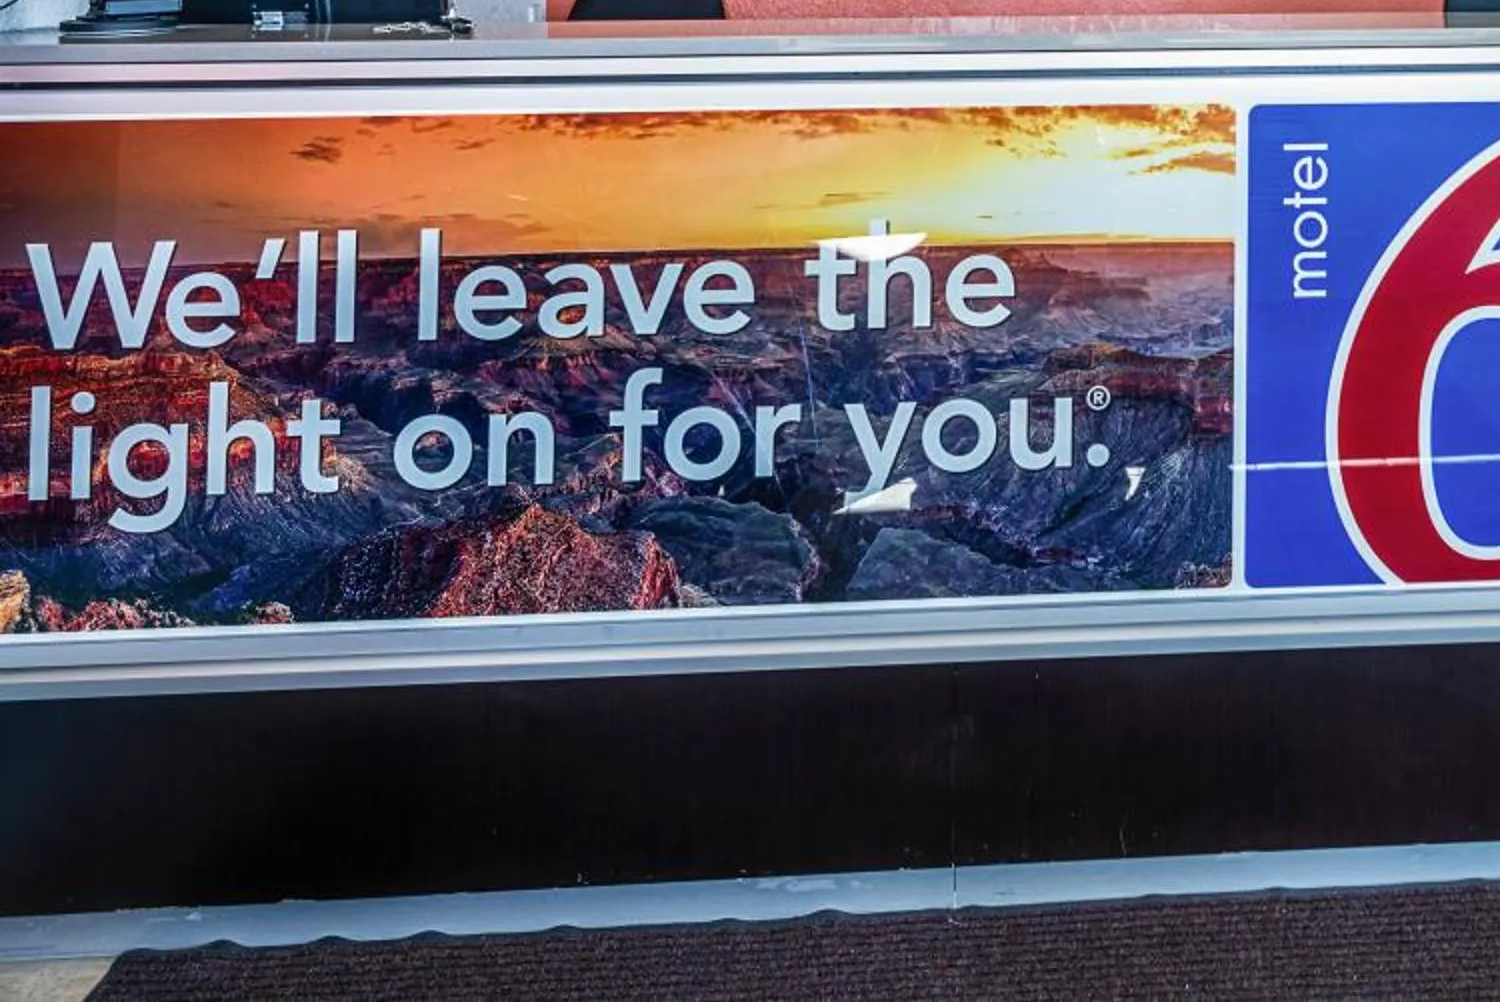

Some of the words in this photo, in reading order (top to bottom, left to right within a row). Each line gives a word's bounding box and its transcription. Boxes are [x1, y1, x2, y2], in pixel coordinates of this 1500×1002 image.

[25, 229, 358, 351] We'll
[417, 227, 755, 341] leave
[804, 218, 1016, 332] the
[1283, 142, 1329, 298] motel
[27, 381, 341, 534] light
[393, 412, 555, 491] on
[609, 367, 801, 484] for
